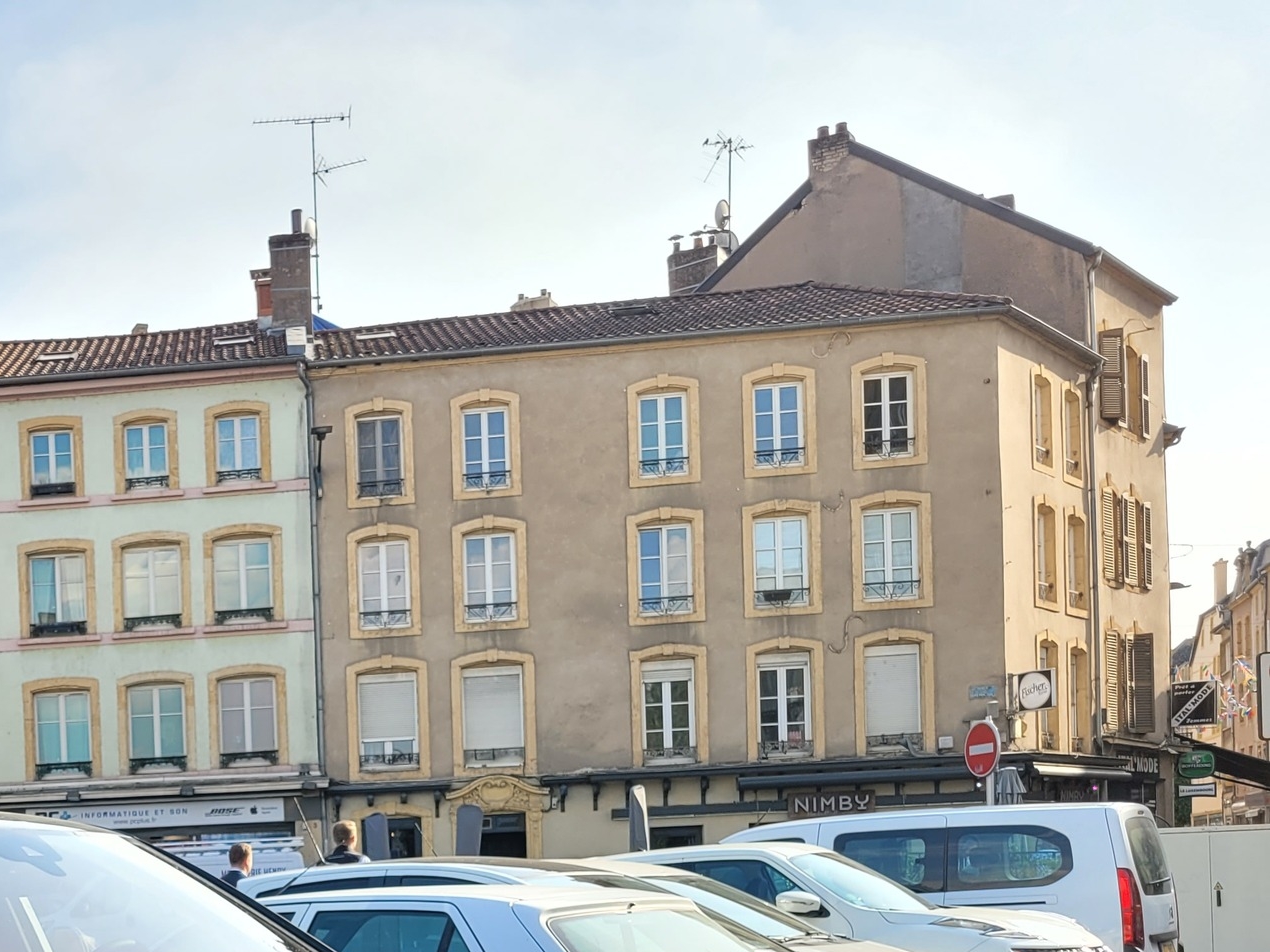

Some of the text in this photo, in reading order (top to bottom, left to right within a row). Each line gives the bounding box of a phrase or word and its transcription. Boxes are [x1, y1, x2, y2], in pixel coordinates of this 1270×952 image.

[794, 794, 870, 813] NIMBY
[80, 809, 149, 819] INFORMATIQUE
[210, 806, 245, 815] BOSE
